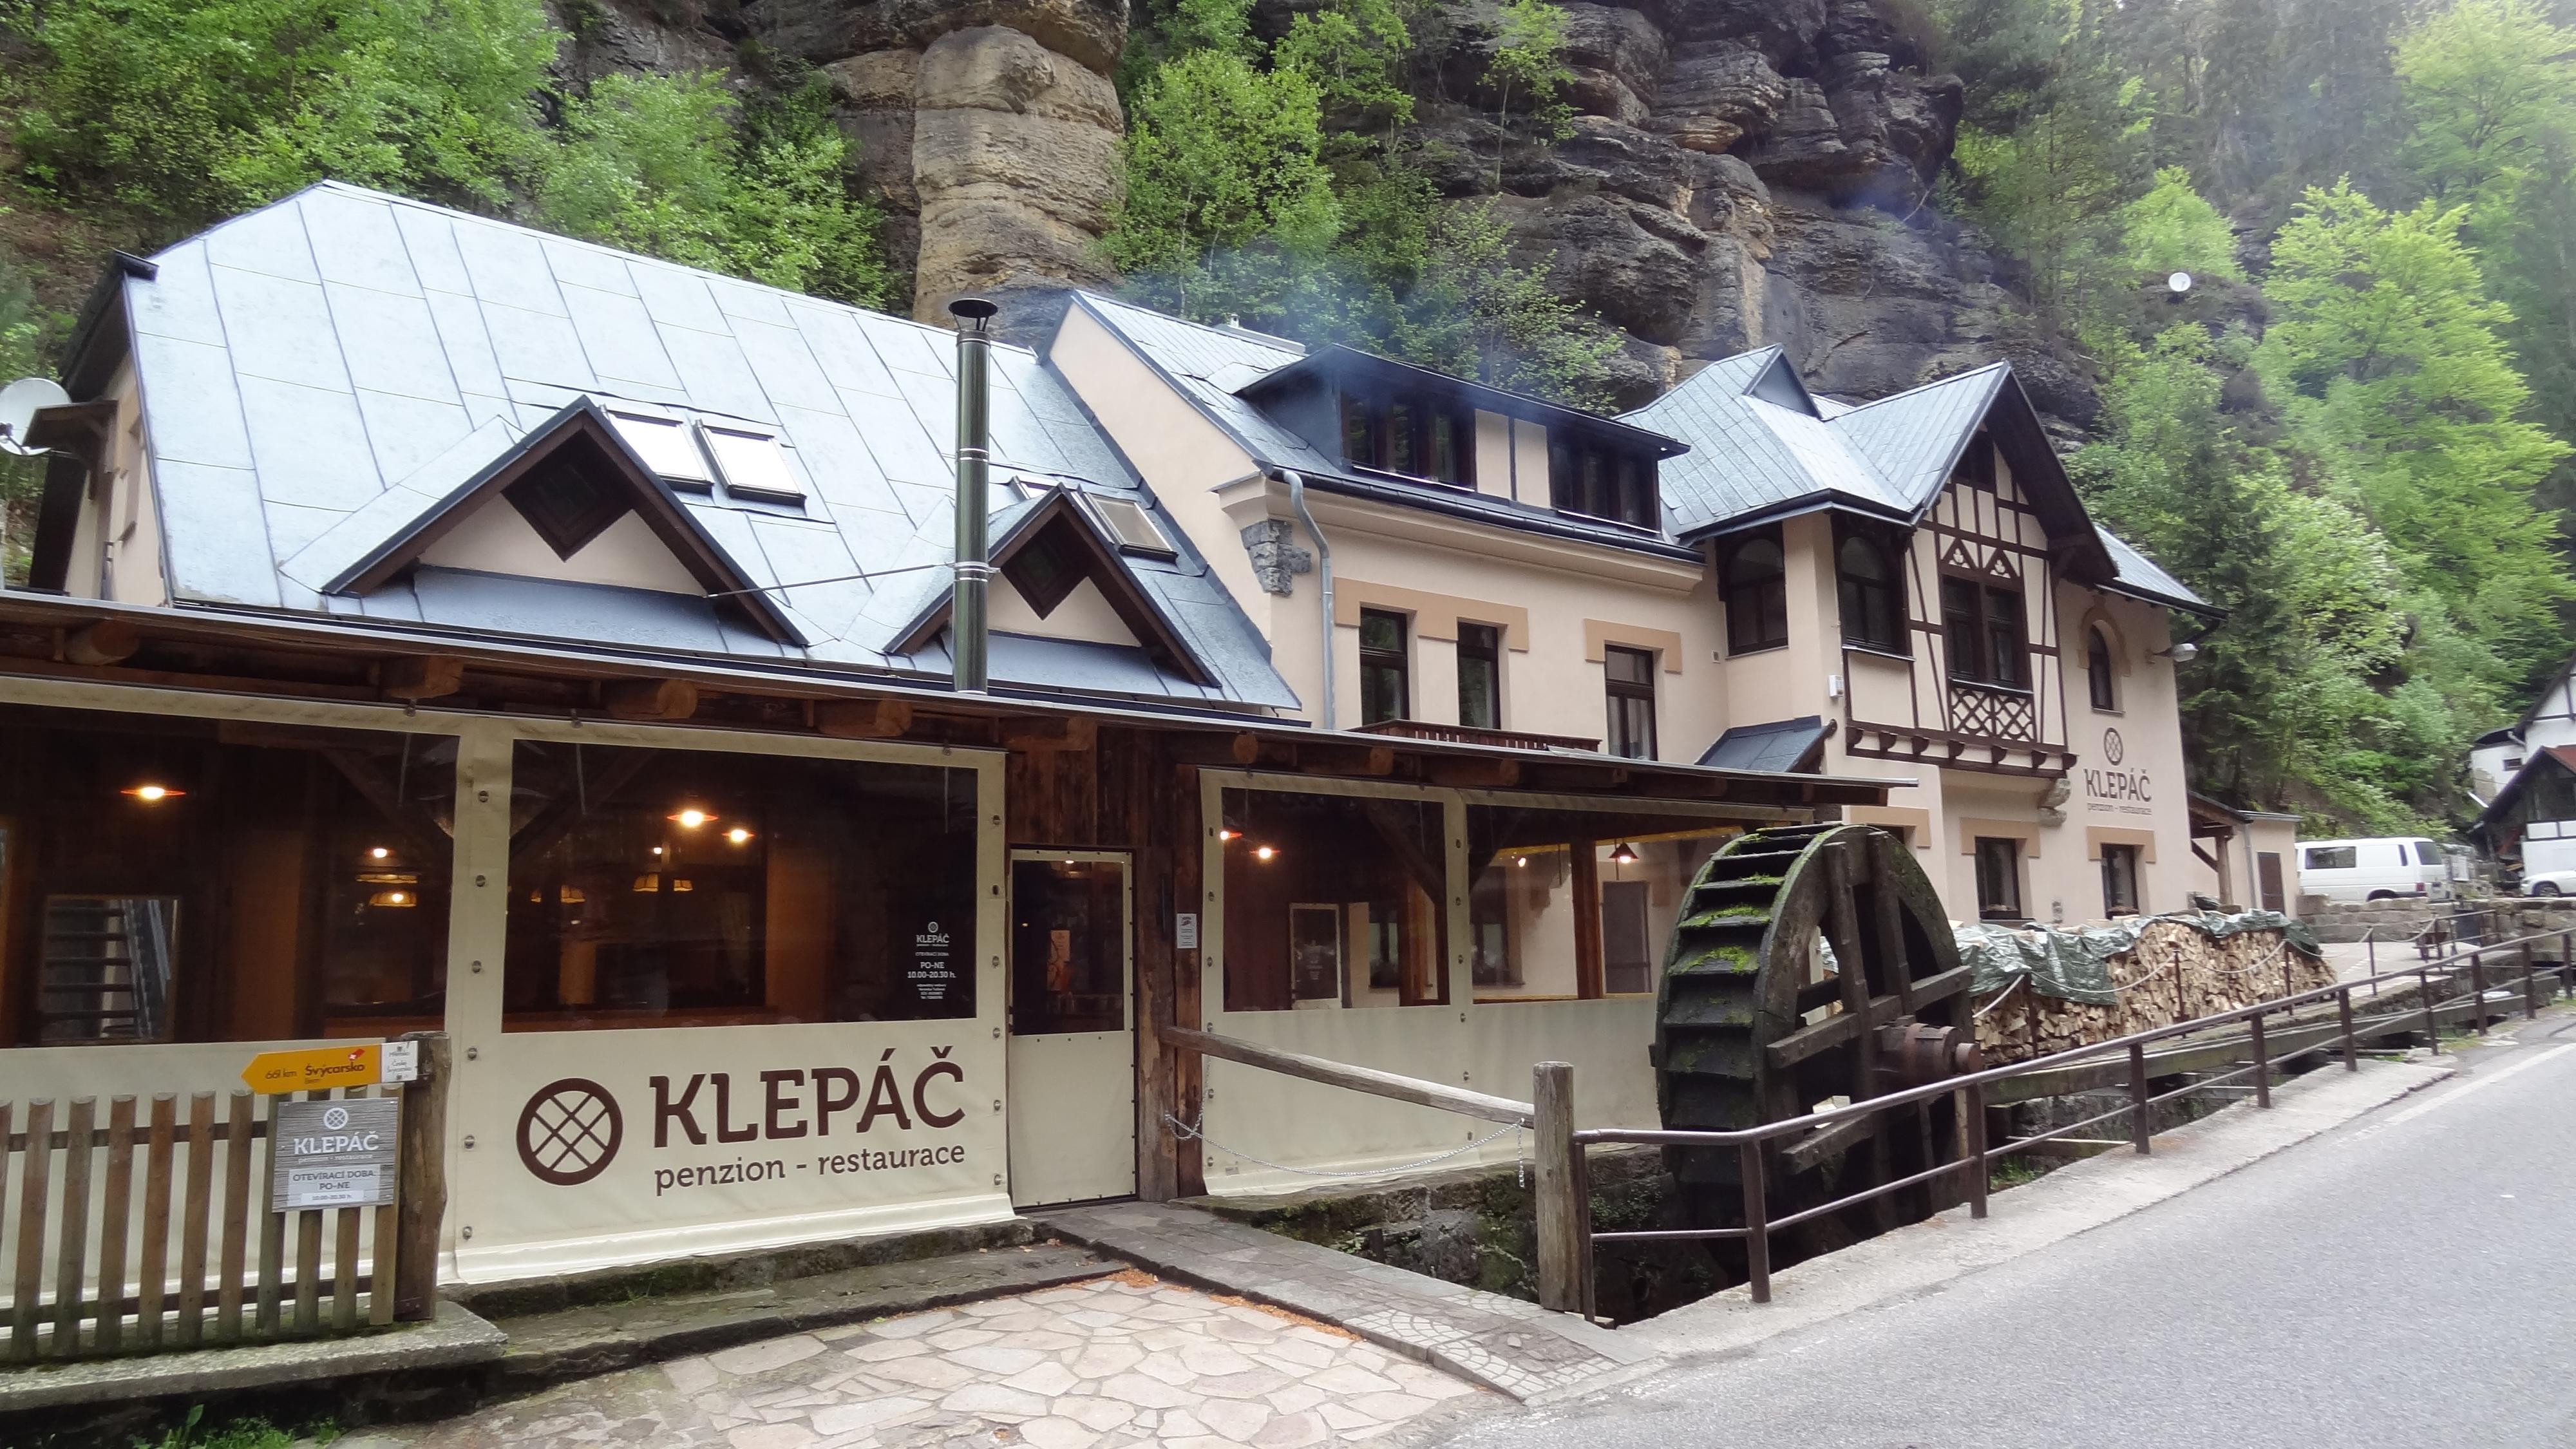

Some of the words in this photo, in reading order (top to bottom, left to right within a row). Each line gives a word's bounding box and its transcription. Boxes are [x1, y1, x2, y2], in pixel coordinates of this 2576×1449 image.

[2083, 768, 2152, 802] KLEPÁČ
[916, 933, 949, 943] KLEPÁČ
[305, 1063, 365, 1077] Švýcarsko
[649, 1046, 966, 1148] KLEPÁČ
[294, 1130, 379, 1155] KLEPÁČ
[654, 1157, 786, 1197] penzion
[818, 1144, 966, 1175] restaurace
[319, 1181, 350, 1190] PO-NE
